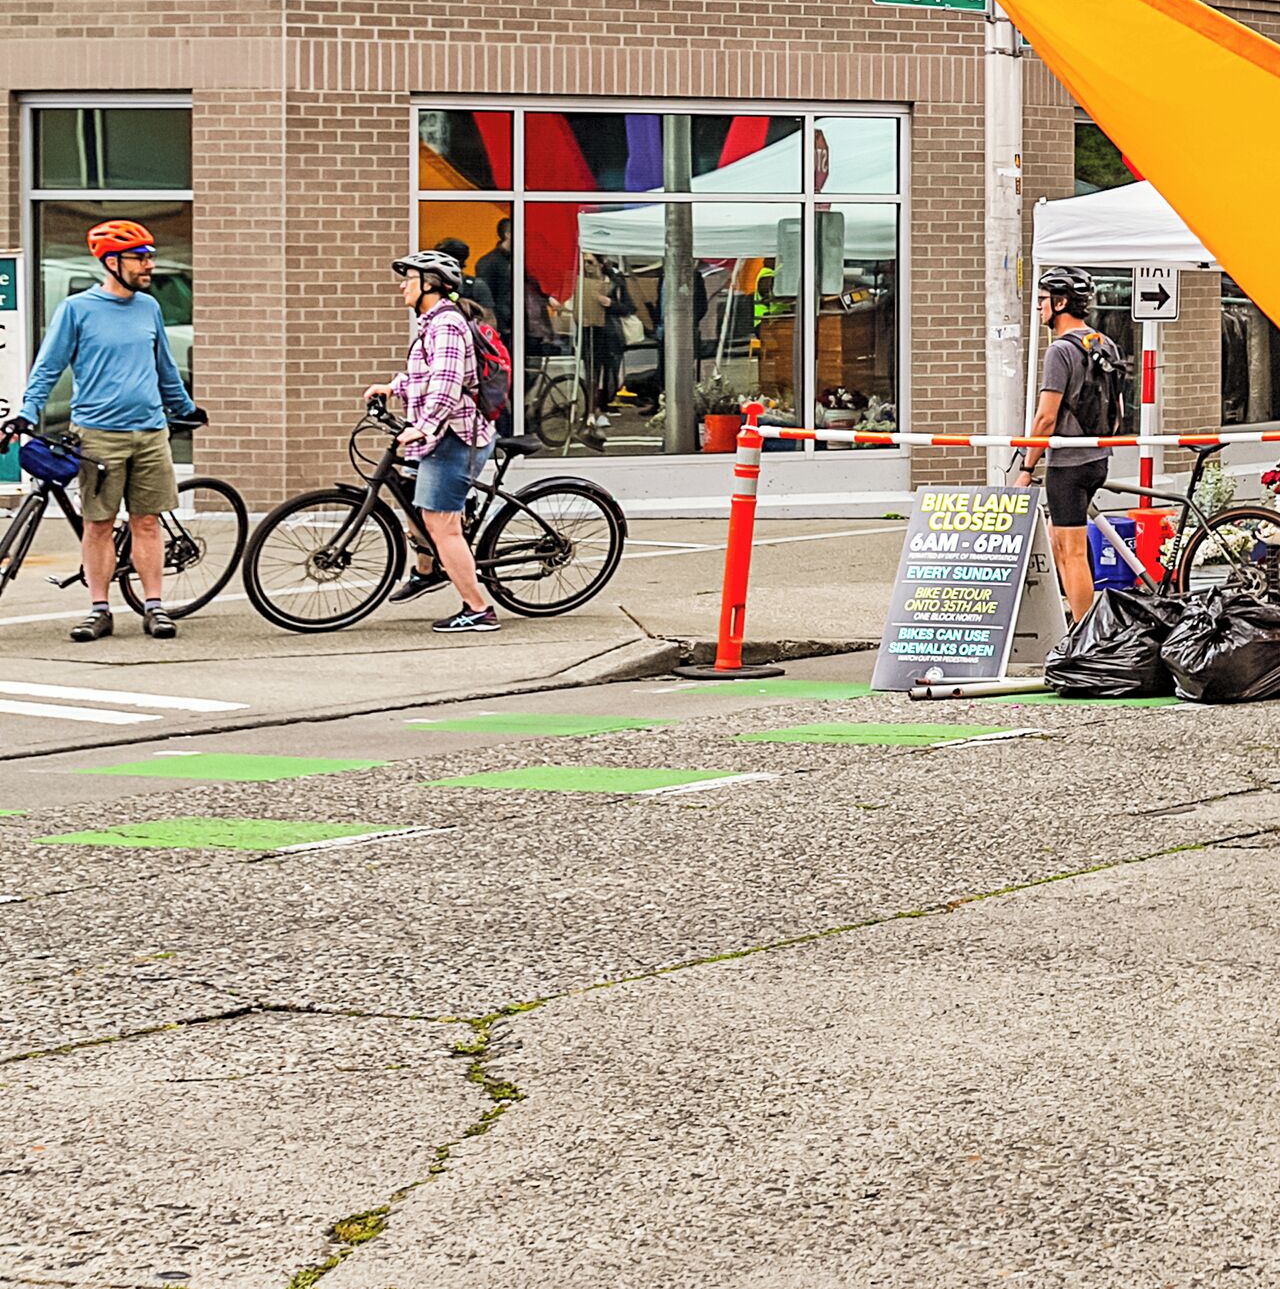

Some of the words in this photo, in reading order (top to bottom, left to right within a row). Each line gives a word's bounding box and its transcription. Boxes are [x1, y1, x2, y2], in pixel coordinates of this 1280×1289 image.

[921, 493, 970, 512] BIKE
[972, 494, 1031, 514] LANE
[928, 511, 1013, 532] CLOSED
[909, 532, 959, 552] 6AM
[973, 534, 1023, 554] 6PM
[907, 566, 952, 579] EVERY
[952, 567, 1011, 581] SUNDAY
[914, 586, 942, 599] BIKE
[941, 587, 992, 601] DETOUR
[904, 599, 940, 612] ONTO
[940, 600, 973, 613] 35TH
[971, 601, 998, 614] AVE
[913, 612, 930, 621] ONE
[930, 613, 956, 621] BLOCK
[956, 614, 982, 622] NORTH
[898, 627, 934, 640] BIKES
[936, 629, 962, 641] CAN
[964, 630, 990, 642] USE
[888, 642, 957, 655] SIDEWALKS
[958, 644, 994, 656] OPEN
